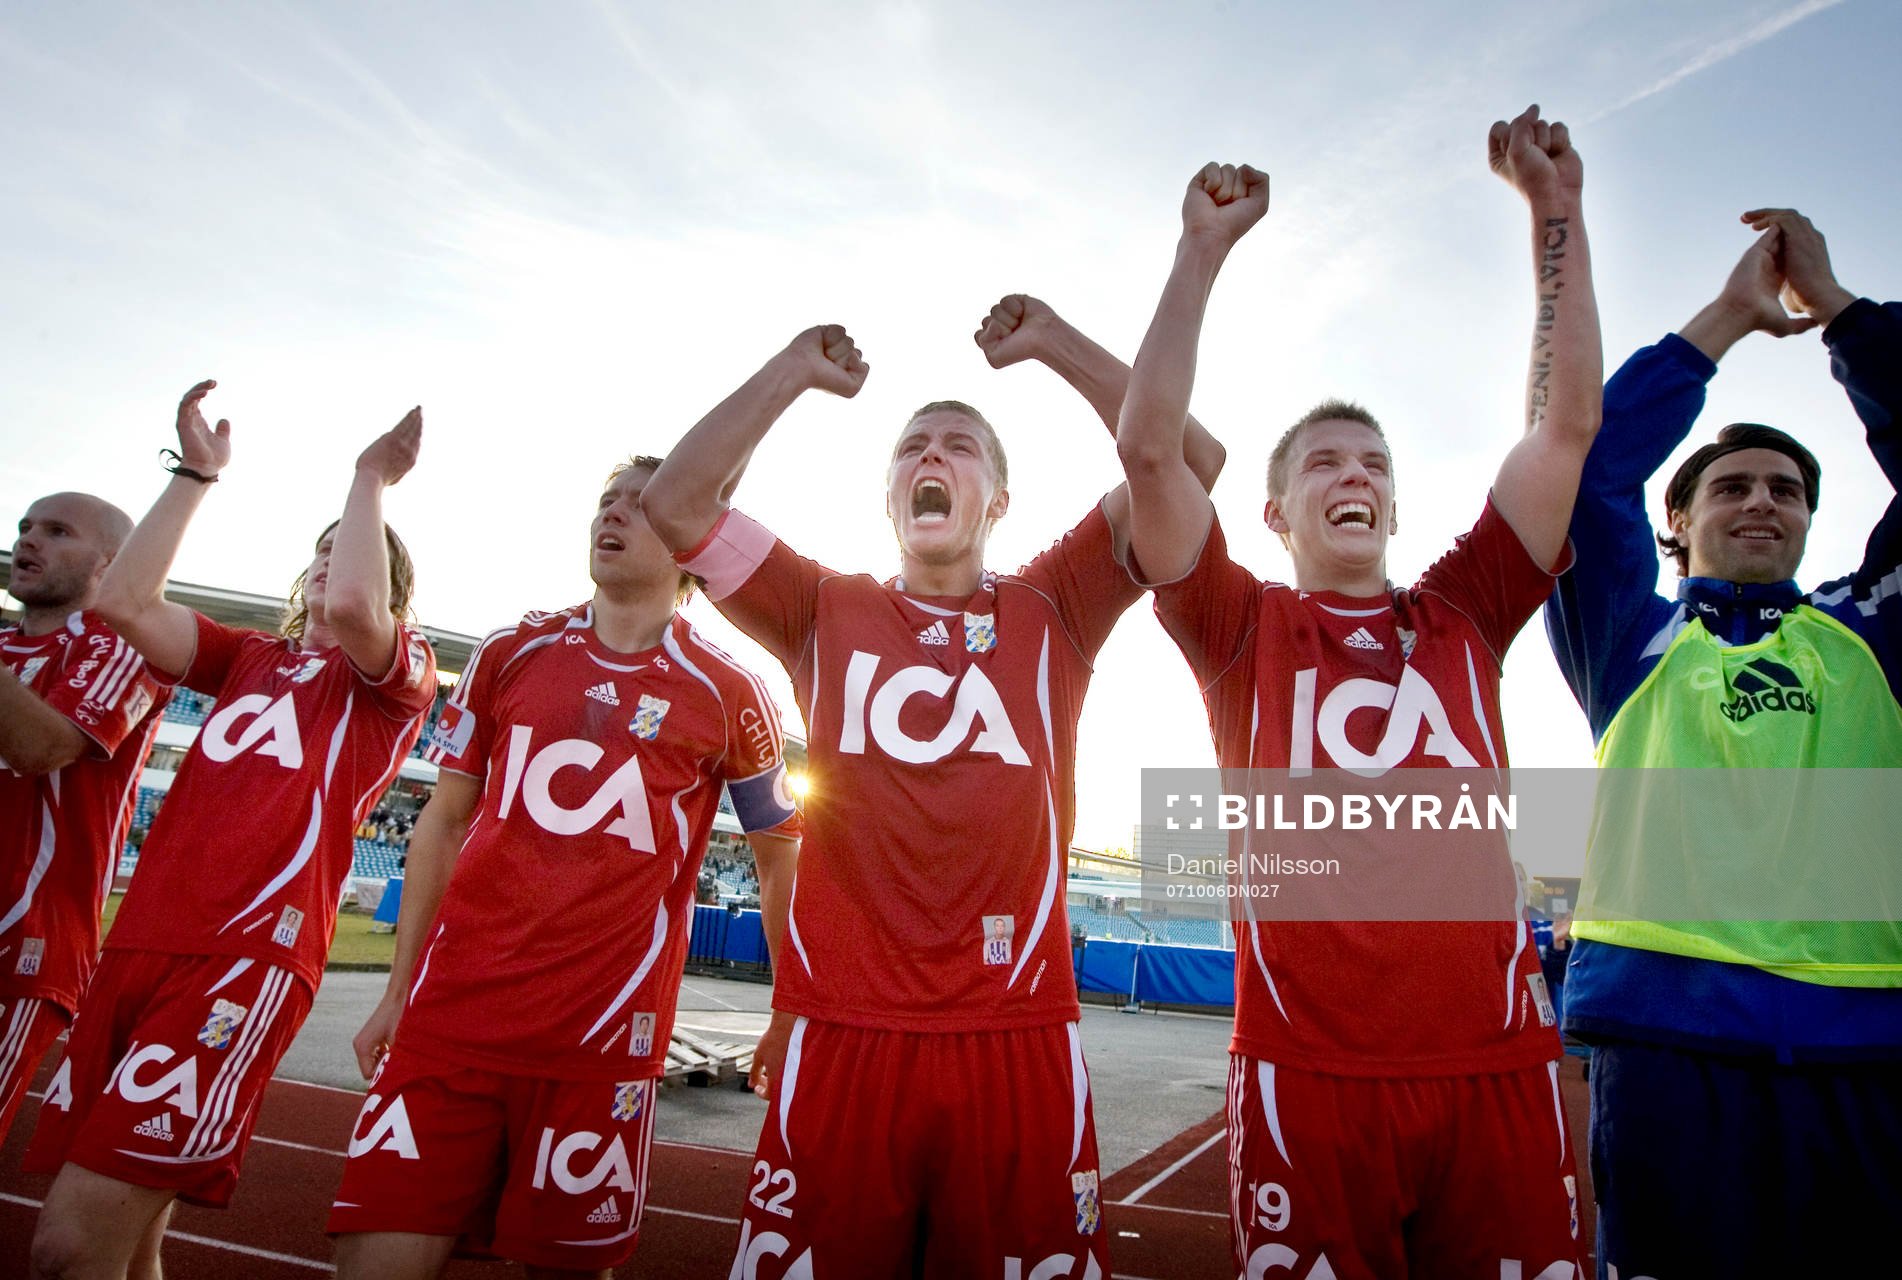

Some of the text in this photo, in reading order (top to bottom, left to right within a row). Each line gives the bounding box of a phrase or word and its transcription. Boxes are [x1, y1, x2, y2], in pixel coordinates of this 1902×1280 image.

[565, 634, 586, 645] ICA
[653, 655, 670, 672] ICA
[1343, 637, 1384, 650] adidas
[584, 687, 620, 706] adidas
[839, 650, 1032, 764] ICA
[1289, 662, 1481, 778] ICA
[1720, 687, 1816, 723] adidas
[202, 691, 304, 769] CA
[498, 724, 657, 855] ICA
[103, 1041, 198, 1119] ICA
[133, 1125, 174, 1142] adidas
[348, 1093, 420, 1159] CA
[532, 1127, 636, 1195] ICA
[586, 1211, 622, 1223] adidas
[749, 1160, 797, 1219] 22
[1249, 1179, 1291, 1231] 19
